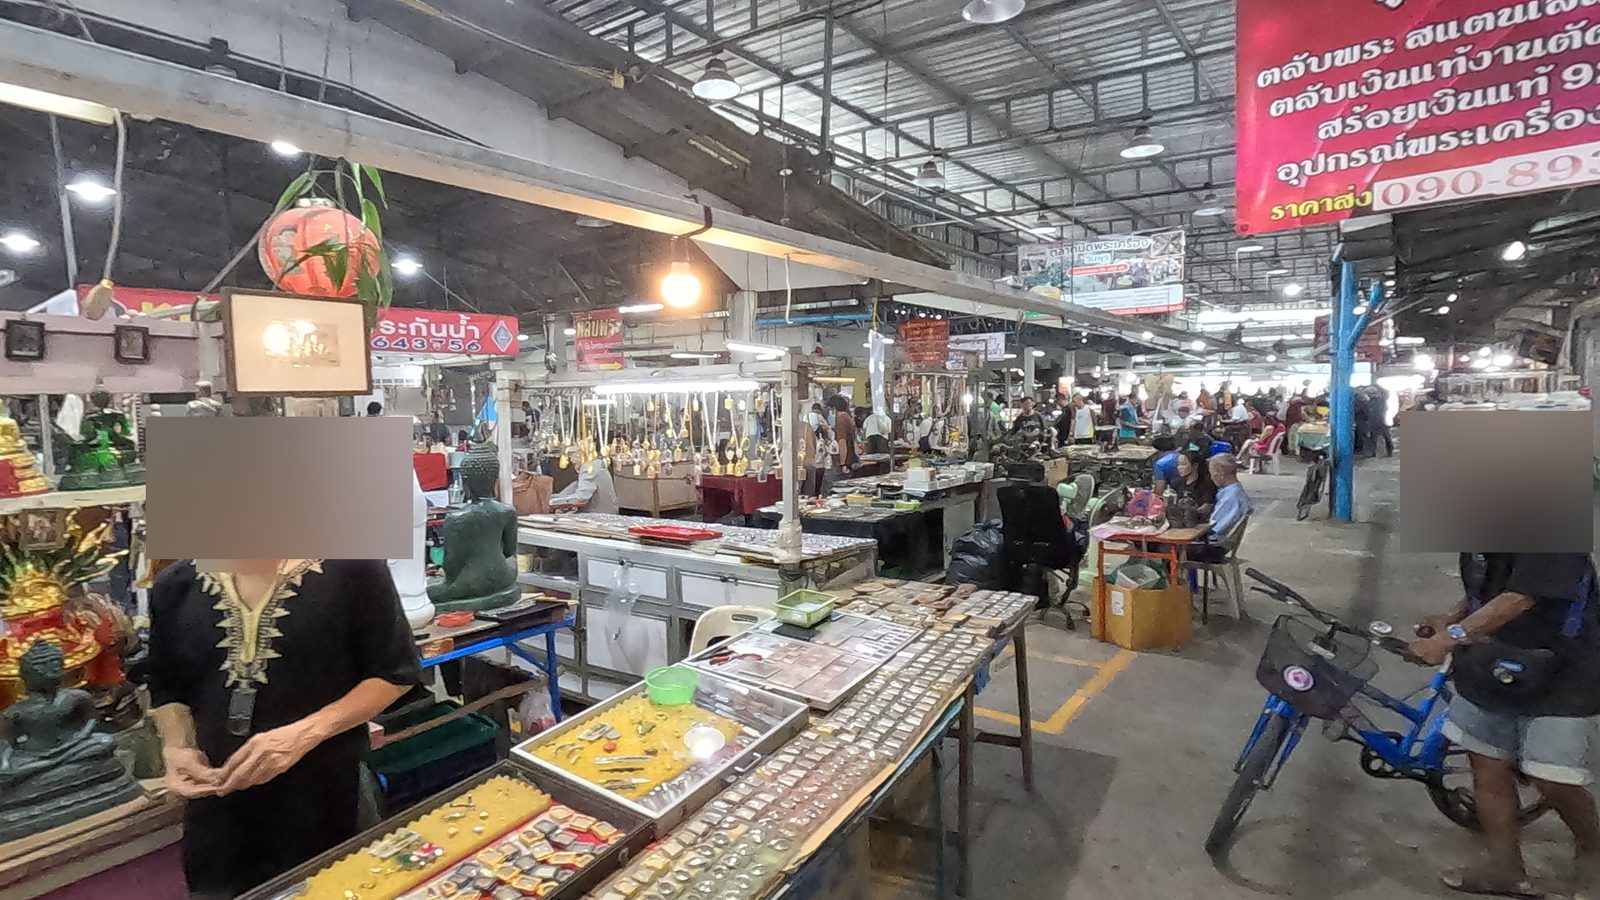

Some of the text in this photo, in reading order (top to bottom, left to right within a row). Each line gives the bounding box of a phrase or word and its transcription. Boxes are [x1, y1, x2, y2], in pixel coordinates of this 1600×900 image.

[1257, 0, 1600, 87] ตลับพระ สแตนเล
[1318, 62, 1600, 139] สร้อยเงินแท้ 9
[1271, 185, 1372, 221] ราคาส่ง
